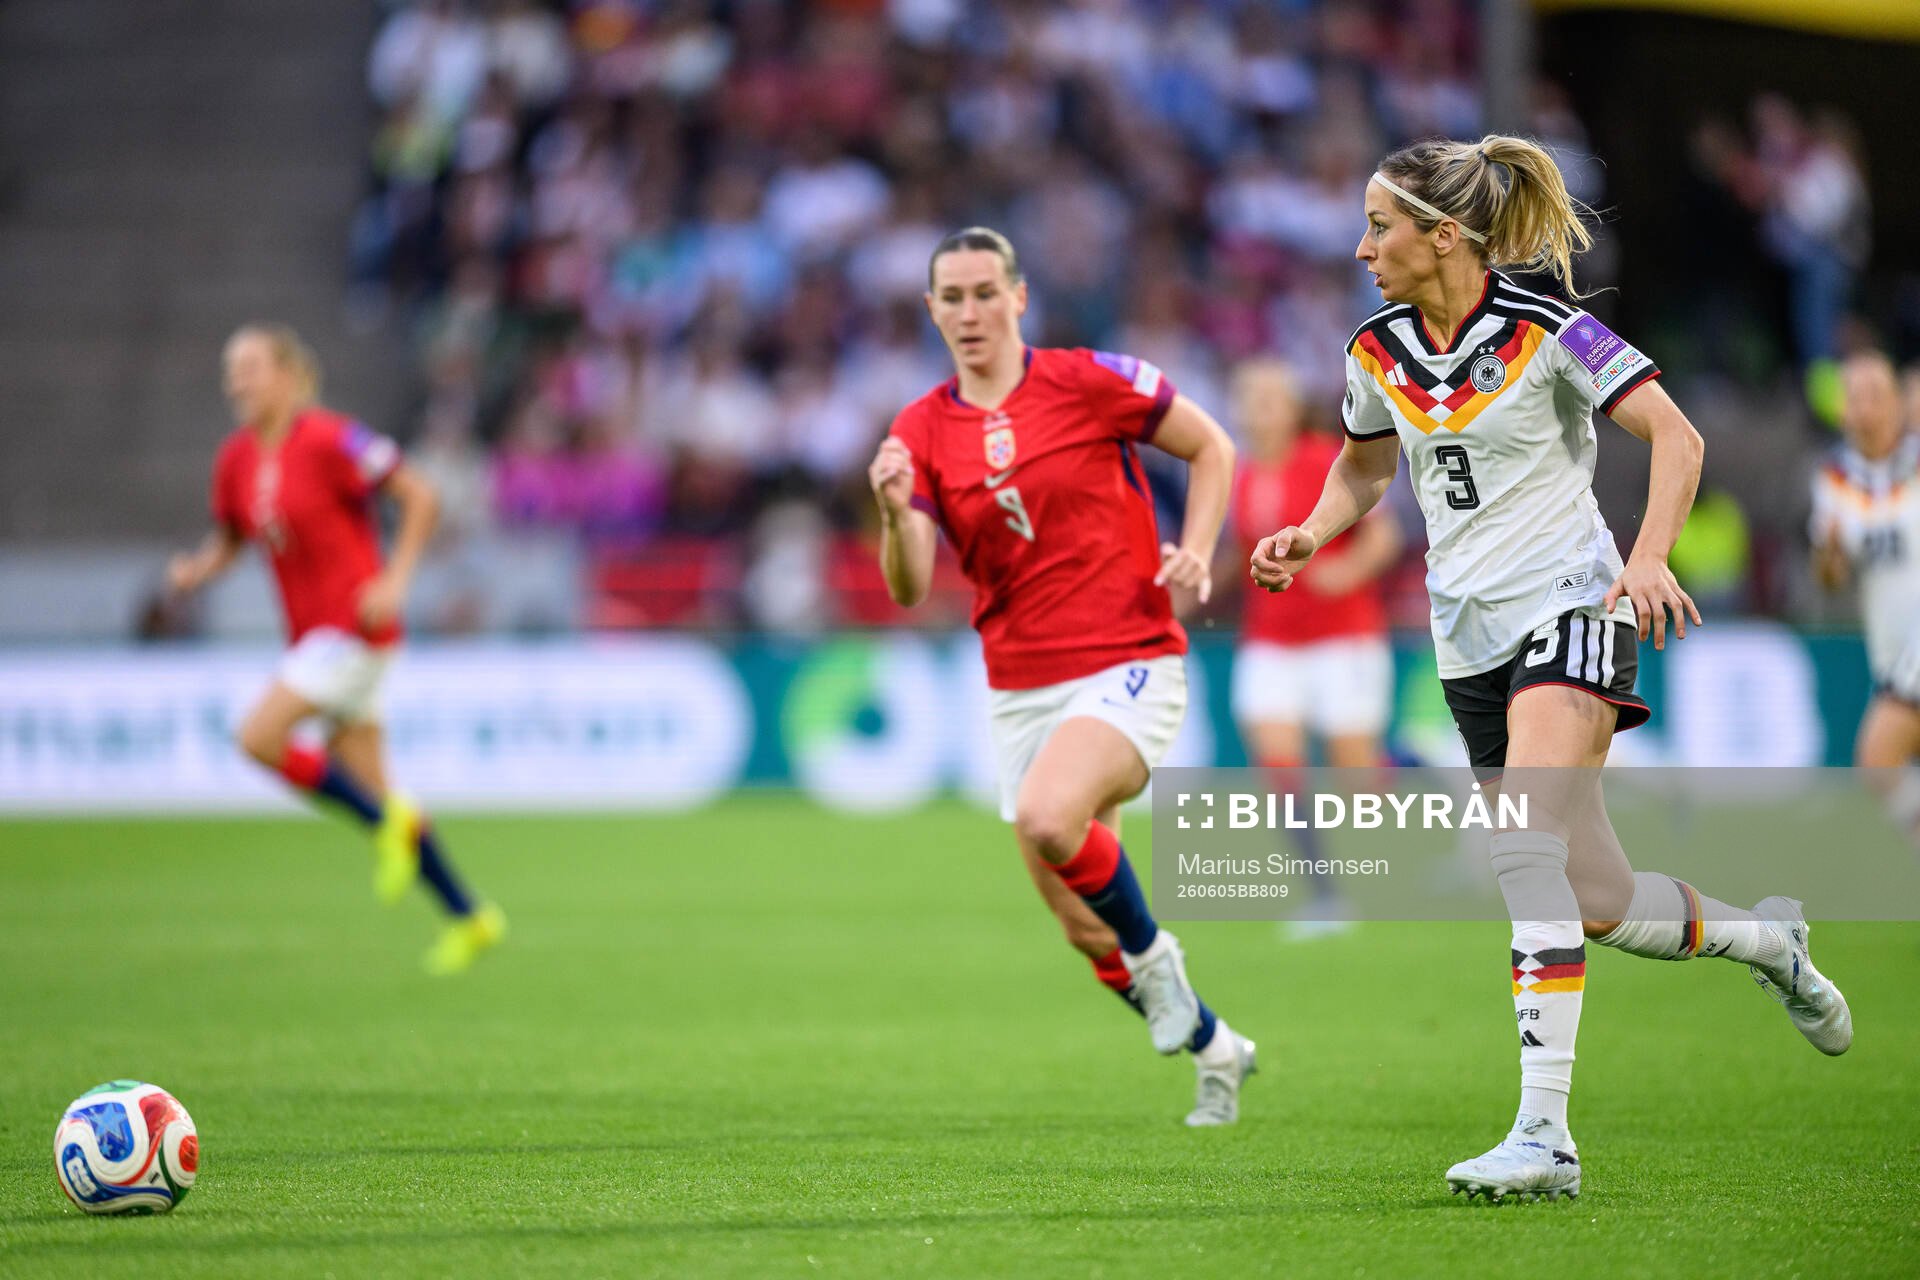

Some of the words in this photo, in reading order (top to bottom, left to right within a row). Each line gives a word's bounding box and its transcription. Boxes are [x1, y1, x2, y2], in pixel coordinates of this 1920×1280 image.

[1586, 335, 1615, 361] EUROPEAN
[1590, 340, 1620, 366] QUALIFIERS
[1594, 350, 1640, 390] FOUNDATION
[1434, 444, 1481, 511] 3
[995, 485, 1036, 543] 9
[1125, 666, 1149, 699] 9
